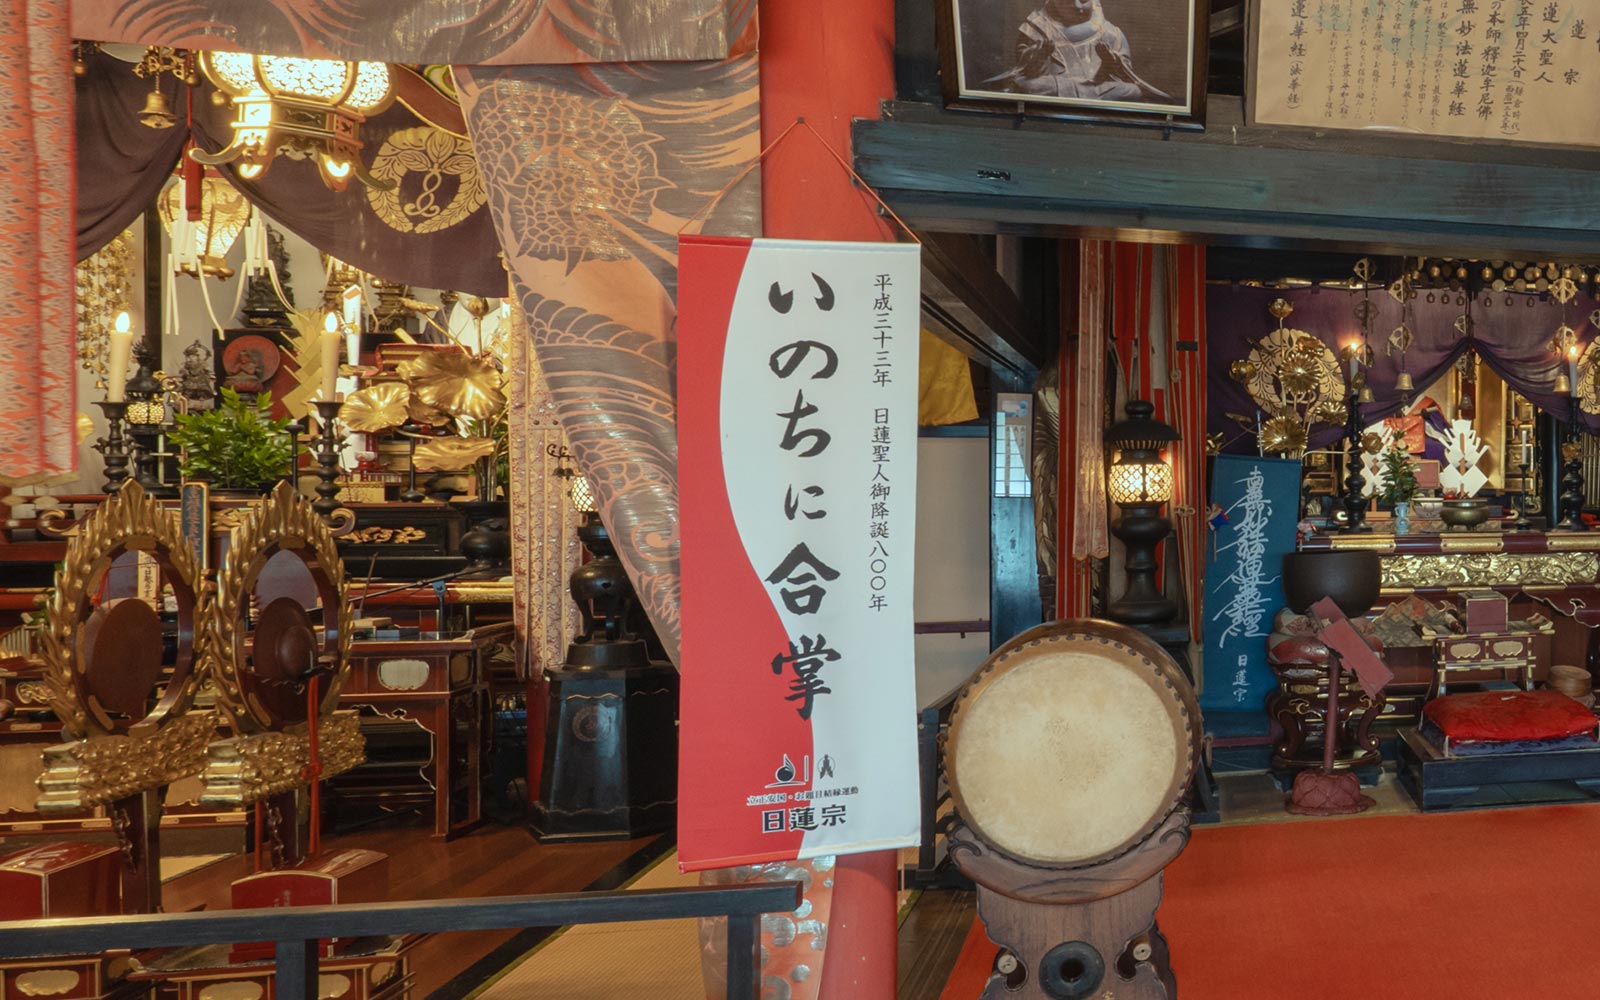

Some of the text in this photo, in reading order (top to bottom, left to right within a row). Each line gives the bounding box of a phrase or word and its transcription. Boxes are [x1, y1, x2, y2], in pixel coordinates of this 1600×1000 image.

[1509, 0, 1535, 79] 五年四月二十八日
[765, 270, 842, 721] いのちに合掌
[868, 273, 893, 612] 平成三十三年 日蓮聖人御降誕八〇〇年
[762, 804, 847, 834] 日蓮宗
